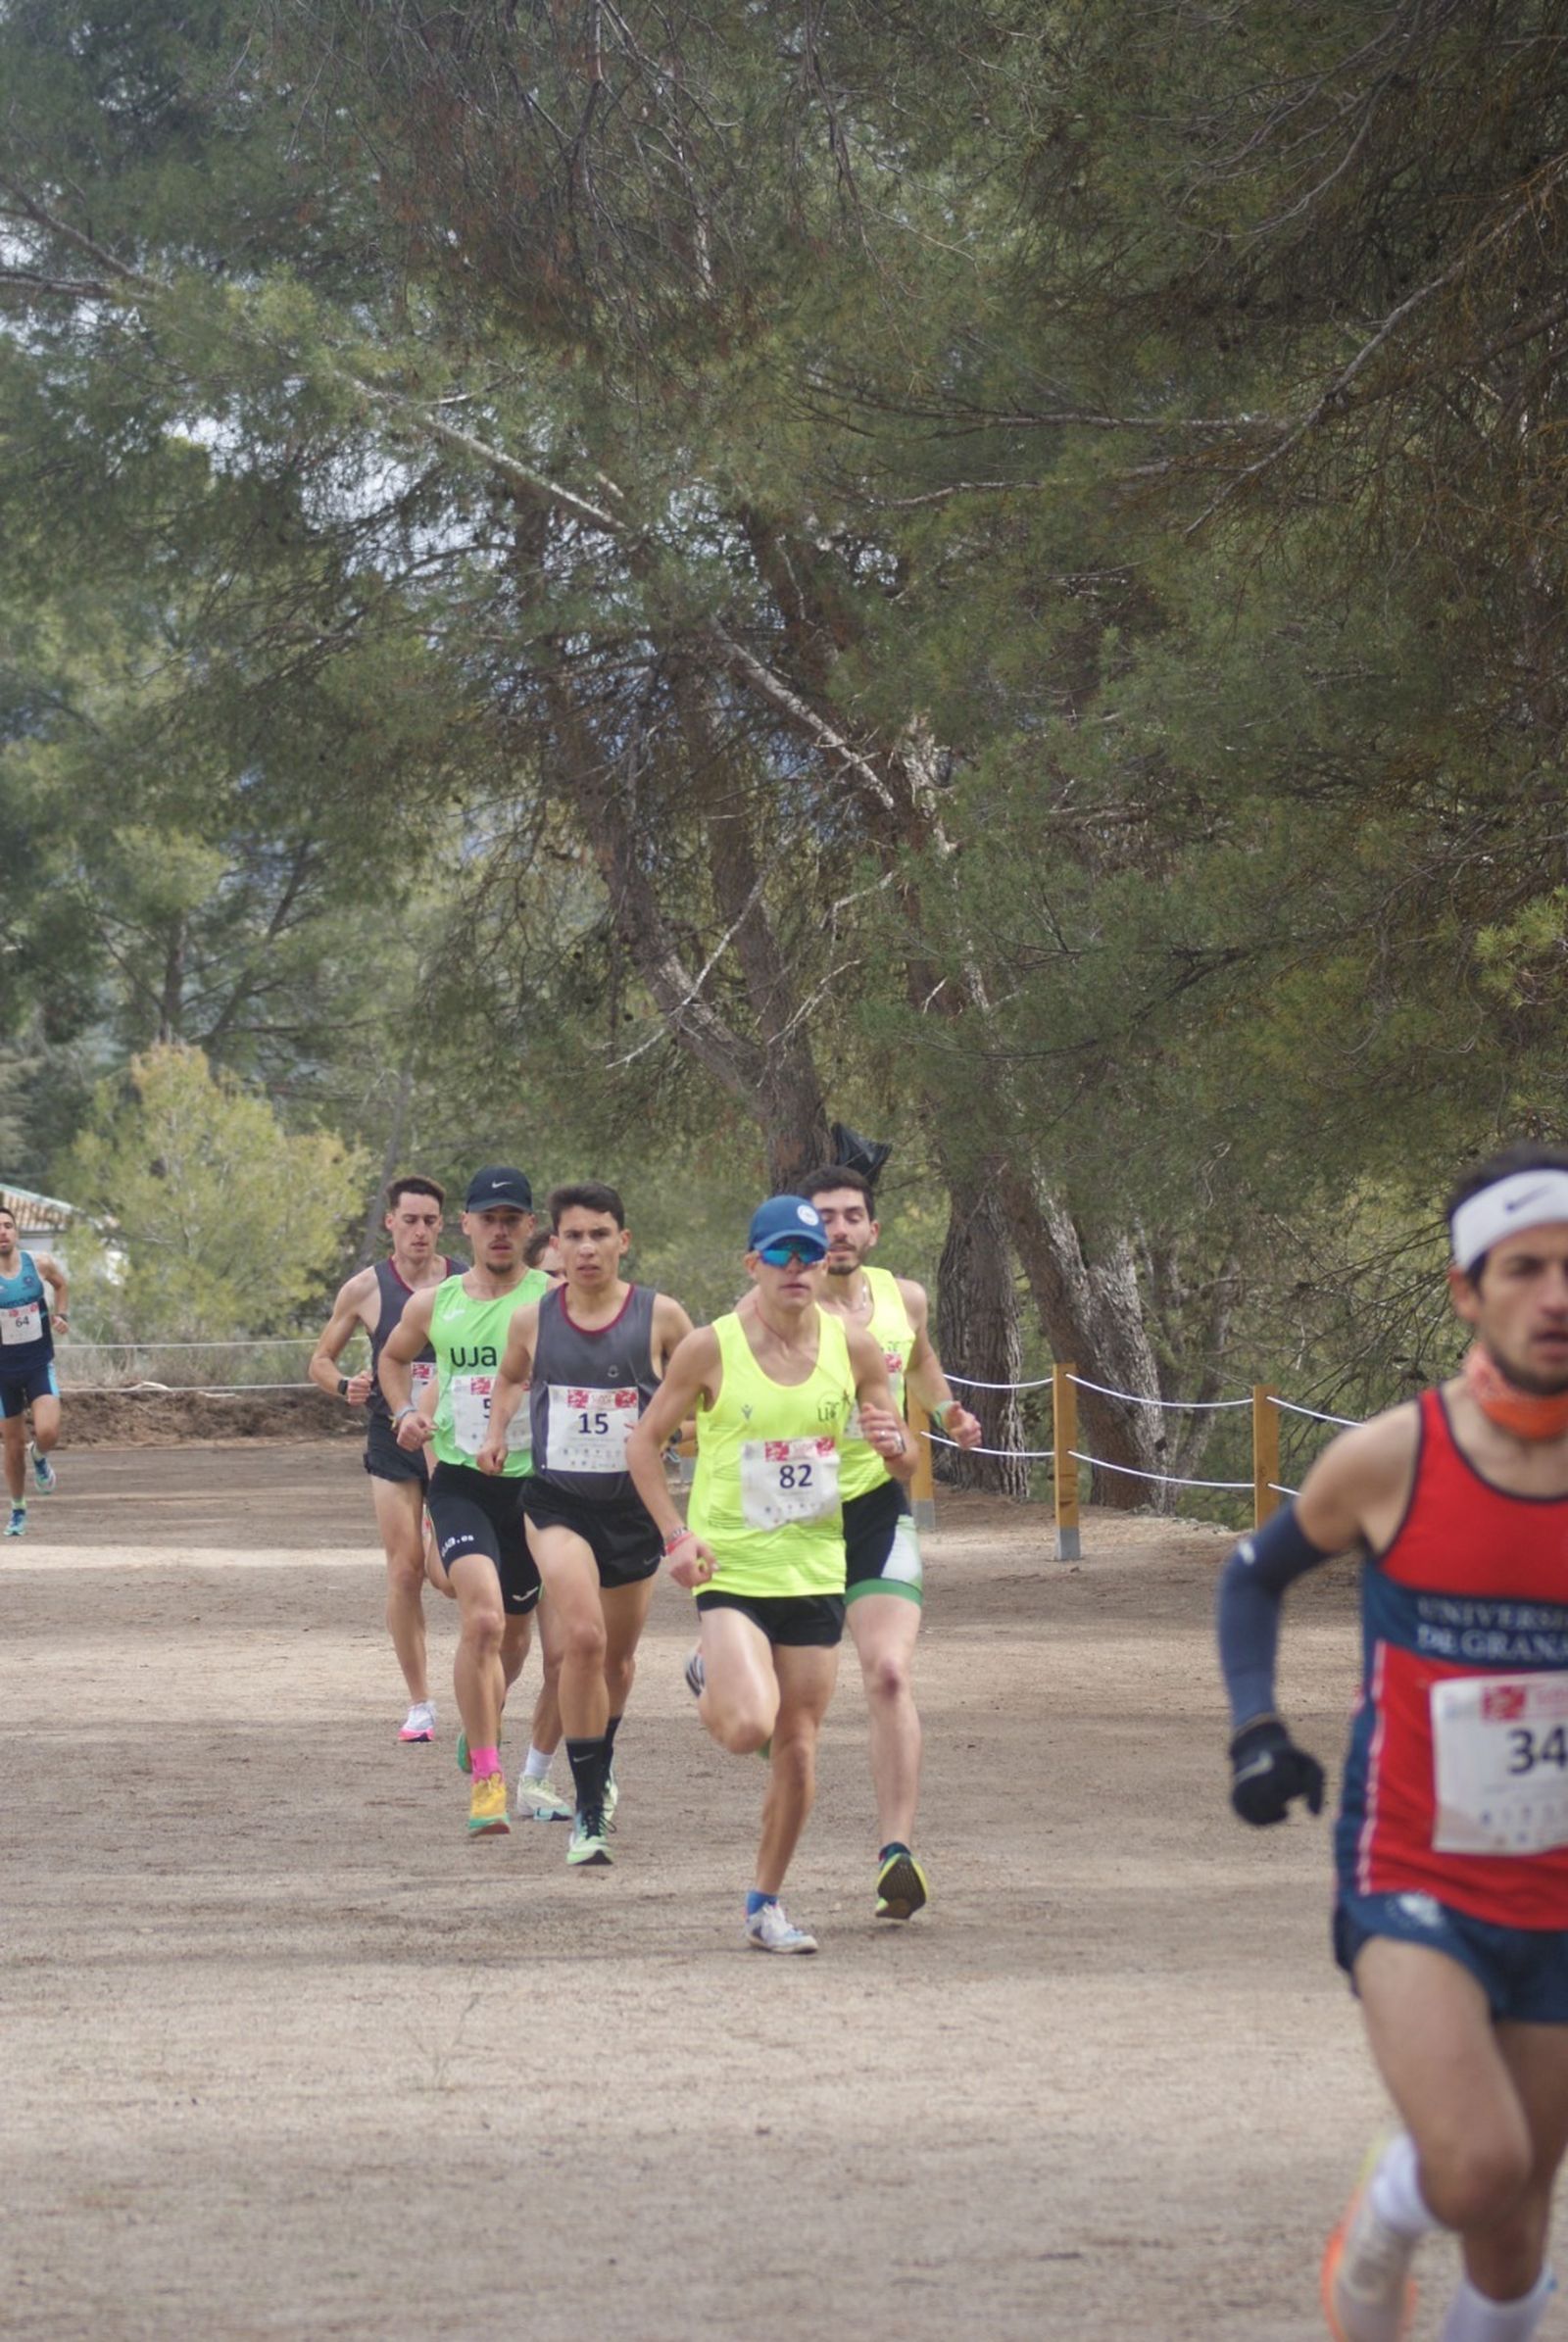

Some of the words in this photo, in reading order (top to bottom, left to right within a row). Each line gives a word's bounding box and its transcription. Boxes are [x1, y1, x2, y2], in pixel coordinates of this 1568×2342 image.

[15, 1316, 29, 1328] 64
[578, 1412, 610, 1435] 15
[779, 1464, 812, 1488] 82
[1417, 1624, 1456, 1655] DE
[1507, 1726, 1568, 1775] 34
